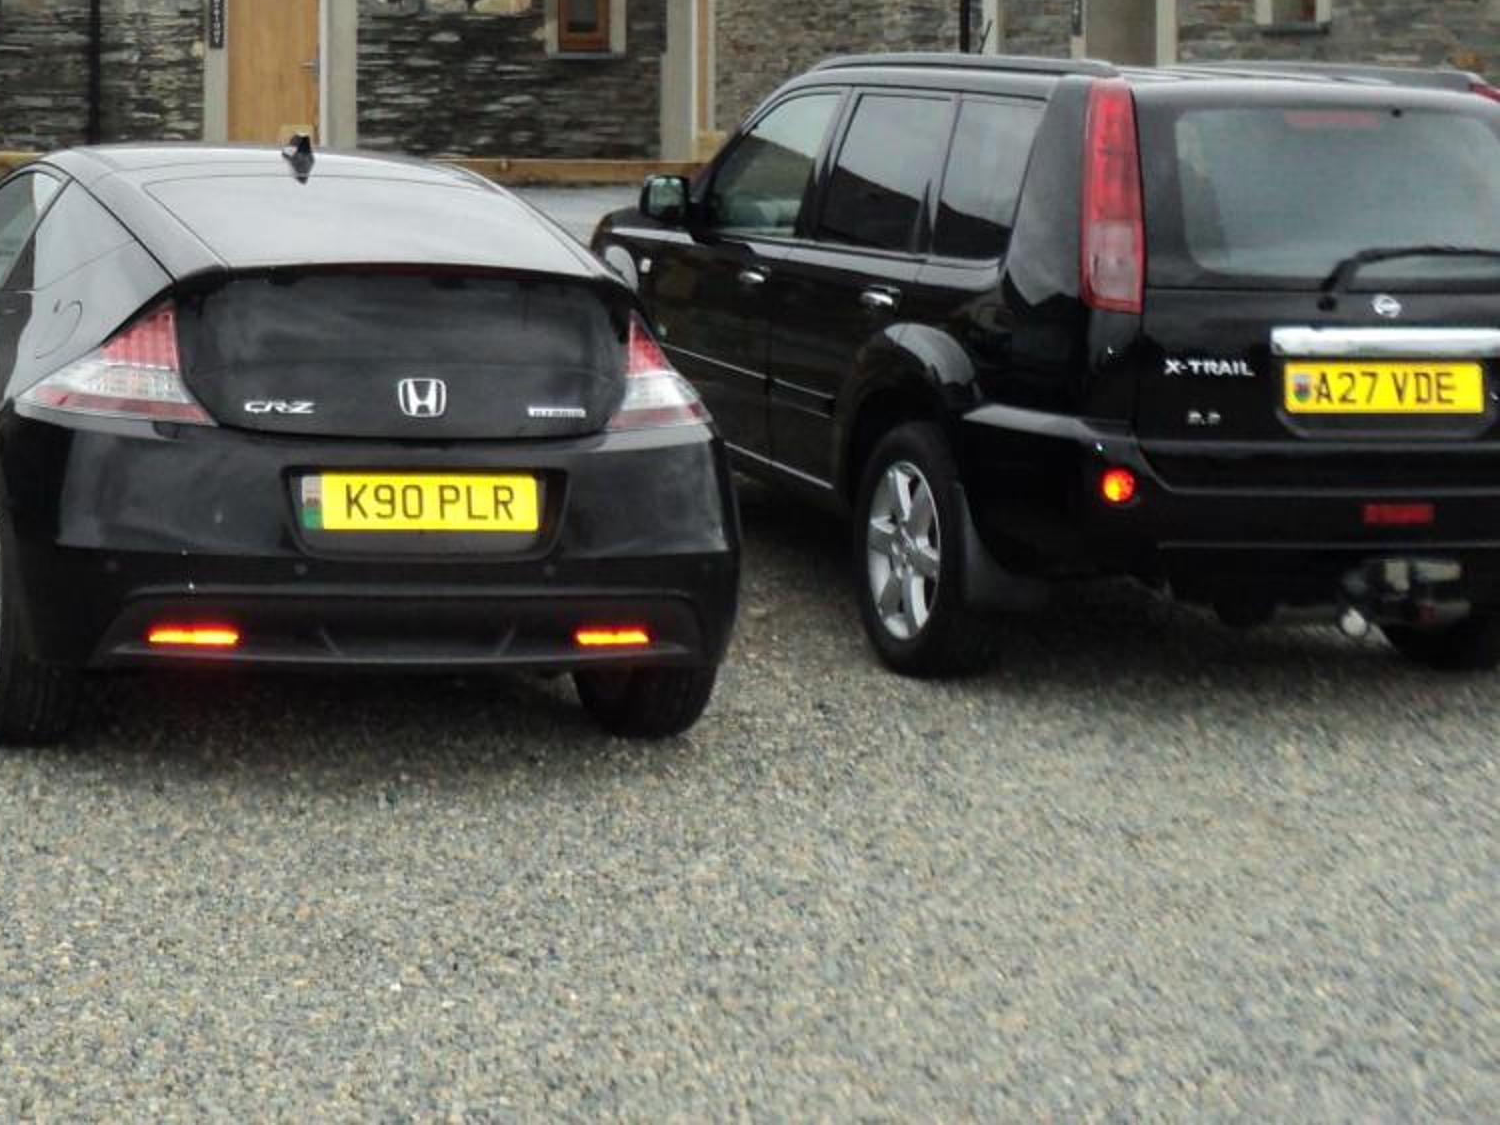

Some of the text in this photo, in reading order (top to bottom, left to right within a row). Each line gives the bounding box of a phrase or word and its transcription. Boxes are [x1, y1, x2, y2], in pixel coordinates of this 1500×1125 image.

[1164, 359, 1255, 377] X-TRAIL
[1315, 371, 1456, 405] A27 VDE
[345, 483, 516, 521] K90 PLR
